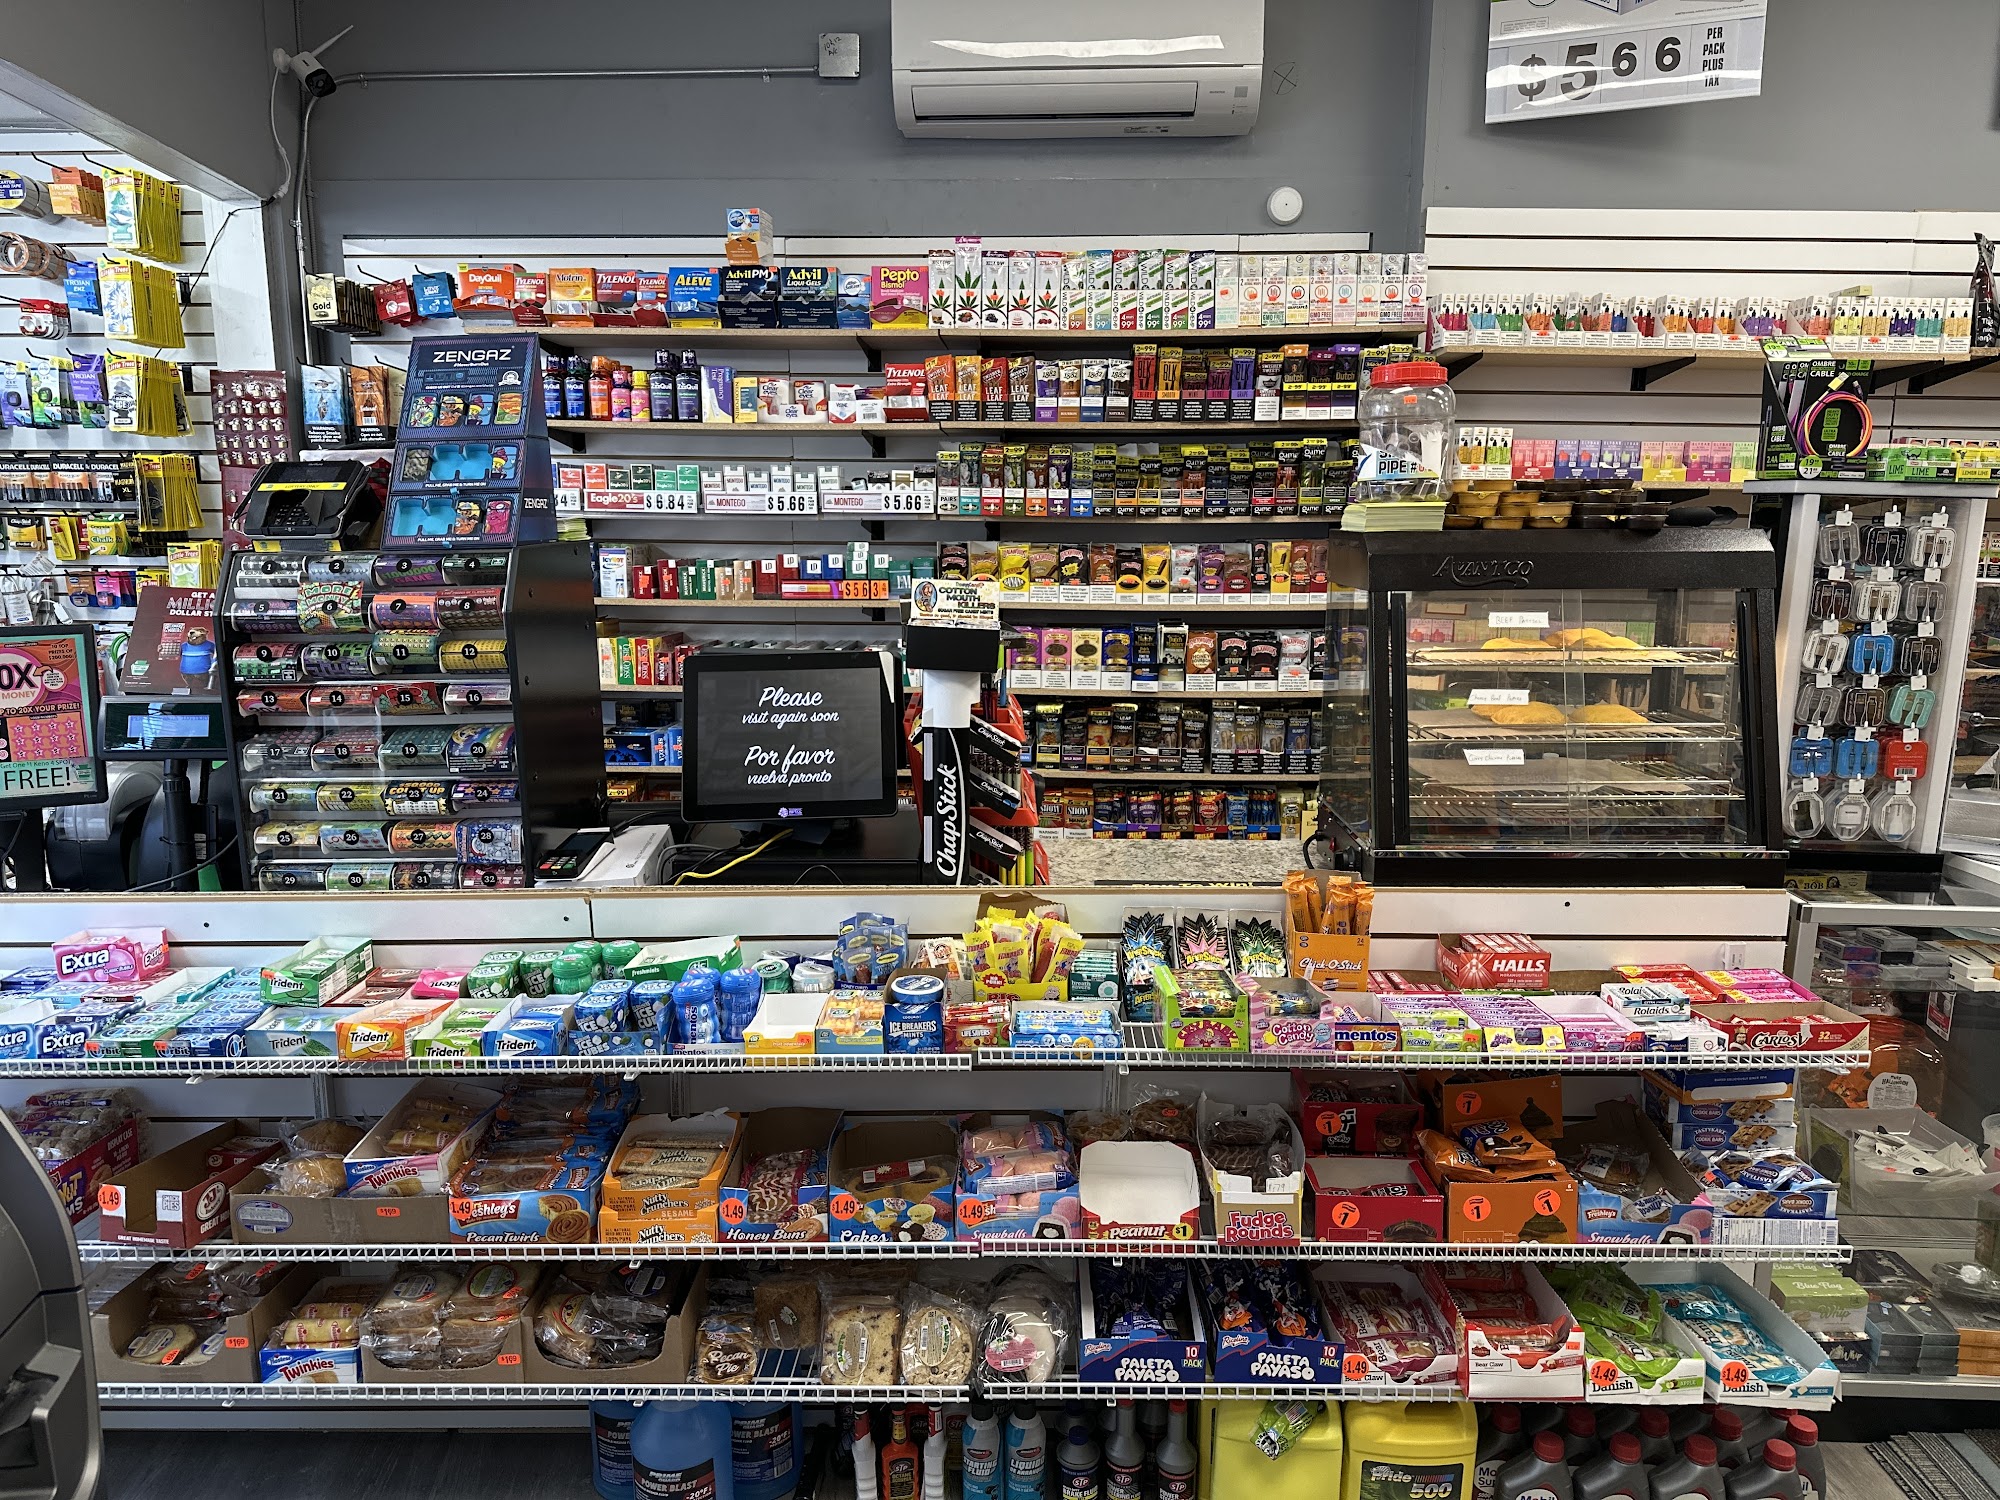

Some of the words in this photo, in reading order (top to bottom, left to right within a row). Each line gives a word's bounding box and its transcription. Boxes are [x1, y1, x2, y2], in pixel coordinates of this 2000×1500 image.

[1707, 26, 1723, 40] PER
[1703, 41, 1725, 56] PACK
[1702, 57, 1723, 72] PLUS
[469, 273, 502, 284] DayQuil
[555, 273, 583, 283] Motrin
[597, 274, 636, 284] TYLENOL
[726, 270, 751, 279] Advil
[752, 269, 769, 278] PM
[787, 269, 821, 280] Advil
[880, 268, 920, 283] Pepto
[515, 277, 545, 286] TYLENOL
[639, 278, 666, 286] TYLENOL
[675, 275, 712, 286] ALEVE
[880, 281, 905, 289] Bismol
[313, 301, 331, 310] Gold
[433, 349, 512, 363] ZENGAZ
[1137, 359, 1152, 377] BLK
[1236, 360, 1250, 378] BLK
[1812, 360, 1836, 368] OMBRE
[886, 368, 925, 378] TYLENOL
[1163, 363, 1177, 380] BLK
[1336, 372, 1355, 380] Dutch
[1810, 370, 1835, 378] CABLE
[1284, 375, 1304, 383] Dutch
[931, 384, 948, 393] LEAF
[959, 384, 976, 393] LEAF
[986, 386, 1002, 395] LEAF
[1011, 385, 1028, 393] LEAF
[1378, 460, 1407, 474] PIPE
[1888, 464, 1904, 475] LIME
[1911, 467, 1930, 476] LIME
[524, 498, 548, 508] ZENGAZ
[590, 492, 638, 504] Eagle20's
[646, 494, 685, 510] $6.84
[716, 498, 746, 507] MONTEGO
[768, 496, 805, 511] $5.66
[834, 498, 864, 506] MONTEGO
[884, 495, 922, 511] $5.66
[90, 536, 113, 544] Chalk
[169, 553, 184, 564] Little
[184, 550, 200, 560] Trees
[946, 594, 980, 602] MOUTH
[958, 602, 996, 610] KILLERS
[2, 691, 36, 699] MONEY
[400, 694, 410, 702] 15
[758, 686, 823, 707] Please
[742, 712, 769, 724] visit
[770, 711, 808, 730] again
[810, 711, 840, 722] soon
[978, 726, 1006, 746] ChapStick
[270, 748, 280, 756] 17
[405, 746, 415, 754] 19
[744, 745, 780, 767] Por
[781, 744, 836, 773] favor
[4, 767, 71, 791] FREE!
[747, 772, 788, 786] vuelva
[788, 770, 833, 787] pronto
[408, 790, 420, 798] 23
[981, 781, 1004, 797] ChapStick
[274, 792, 285, 800] 21
[1068, 806, 1090, 816] SHOW
[936, 764, 957, 876] ChapStick
[280, 834, 290, 842] 25
[413, 833, 424, 841] 27
[976, 831, 1004, 850] ChapStick
[284, 876, 296, 884] 29
[417, 876, 428, 884] 31
[62, 949, 110, 974] Extra
[1300, 958, 1363, 972] Chick-O-Stick
[1492, 959, 1546, 972] HALLS
[631, 967, 660, 978] freshmints
[1634, 1007, 1670, 1016] Rolaids
[888, 1021, 900, 1032] ICE
[900, 1020, 936, 1032] BREAKERS
[1272, 1022, 1312, 1036] Cotton
[43, 1030, 84, 1052] Extra
[349, 1032, 389, 1044] Trident
[1279, 1032, 1314, 1046] Candy
[1334, 1029, 1398, 1042] mentos
[1818, 1031, 1830, 1040] 32
[270, 1035, 308, 1050] Trident
[495, 1039, 537, 1051] Trident
[659, 1149, 688, 1159] Nutty
[650, 1156, 706, 1166] Crunchers
[363, 1166, 418, 1190] Twinkies
[162, 1200, 180, 1211] PIES
[642, 1193, 668, 1206] Nutty
[640, 1200, 690, 1216] Crunchers
[959, 1204, 983, 1220] $1.49
[1230, 1211, 1287, 1230] Fudge
[1587, 1209, 1618, 1220] Freshley's
[200, 1218, 219, 1234] GREAT
[638, 1224, 666, 1239] Nutty
[1175, 1224, 1188, 1237] $1
[466, 1232, 504, 1243] Pecan
[504, 1232, 540, 1243] Twirls
[726, 1228, 770, 1242] Honey
[772, 1228, 807, 1240] Buns
[840, 1230, 890, 1243] Cakes
[970, 1229, 1027, 1240] Snowballs
[1109, 1225, 1167, 1240] Peanut
[1225, 1224, 1294, 1242] Rounds
[1588, 1232, 1652, 1244] Snowballs
[1796, 1281, 1819, 1290] Blue
[1820, 1282, 1844, 1292] Flag
[1820, 1304, 1851, 1320] Whip
[1222, 1334, 1250, 1347] Ricolino
[1084, 1342, 1112, 1355] Ricolino
[1186, 1346, 1198, 1357] 10
[1324, 1346, 1336, 1357] 10
[1121, 1358, 1174, 1370] PALETA
[1182, 1358, 1202, 1368] PACK
[1257, 1352, 1310, 1366] PALETA
[1320, 1358, 1340, 1368] PACK
[279, 1360, 335, 1382] Twinkies
[715, 1362, 740, 1374] Pie
[1250, 1362, 1315, 1380] PAYASO
[1343, 1360, 1368, 1374] $1.49
[1114, 1368, 1180, 1382] PAYASO
[1364, 1374, 1384, 1382] Claw
[1590, 1366, 1616, 1382] $1.49
[1722, 1366, 1748, 1382] $1.49
[962, 1460, 998, 1469] STARTING
[967, 1468, 992, 1476] FLUID
[1371, 1467, 1413, 1483] Pride
[641, 1480, 668, 1492] POWER
[669, 1480, 698, 1492] BLAST
[1074, 1478, 1088, 1486] STP
[1116, 1476, 1130, 1484] STP
[1170, 1482, 1185, 1491] STP
[1409, 1483, 1452, 1499] 500
